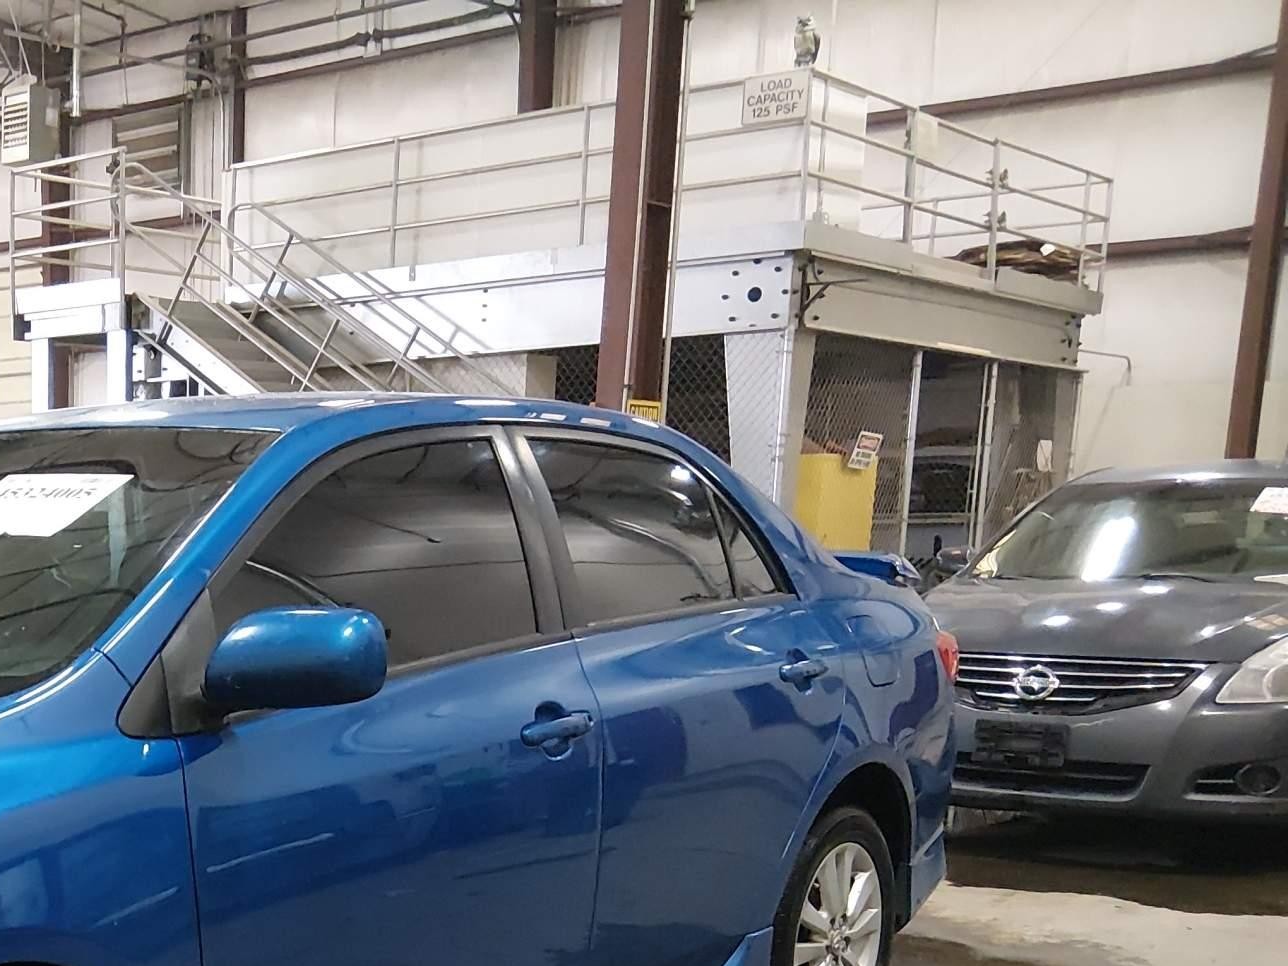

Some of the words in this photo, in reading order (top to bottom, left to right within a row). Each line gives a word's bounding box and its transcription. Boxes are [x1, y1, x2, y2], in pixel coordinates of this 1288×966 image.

[760, 78, 793, 93] LOAD
[747, 88, 804, 107] CAPACITY
[752, 106, 770, 119] 125
[775, 102, 799, 116] PSF
[631, 405, 658, 421] CAUTION
